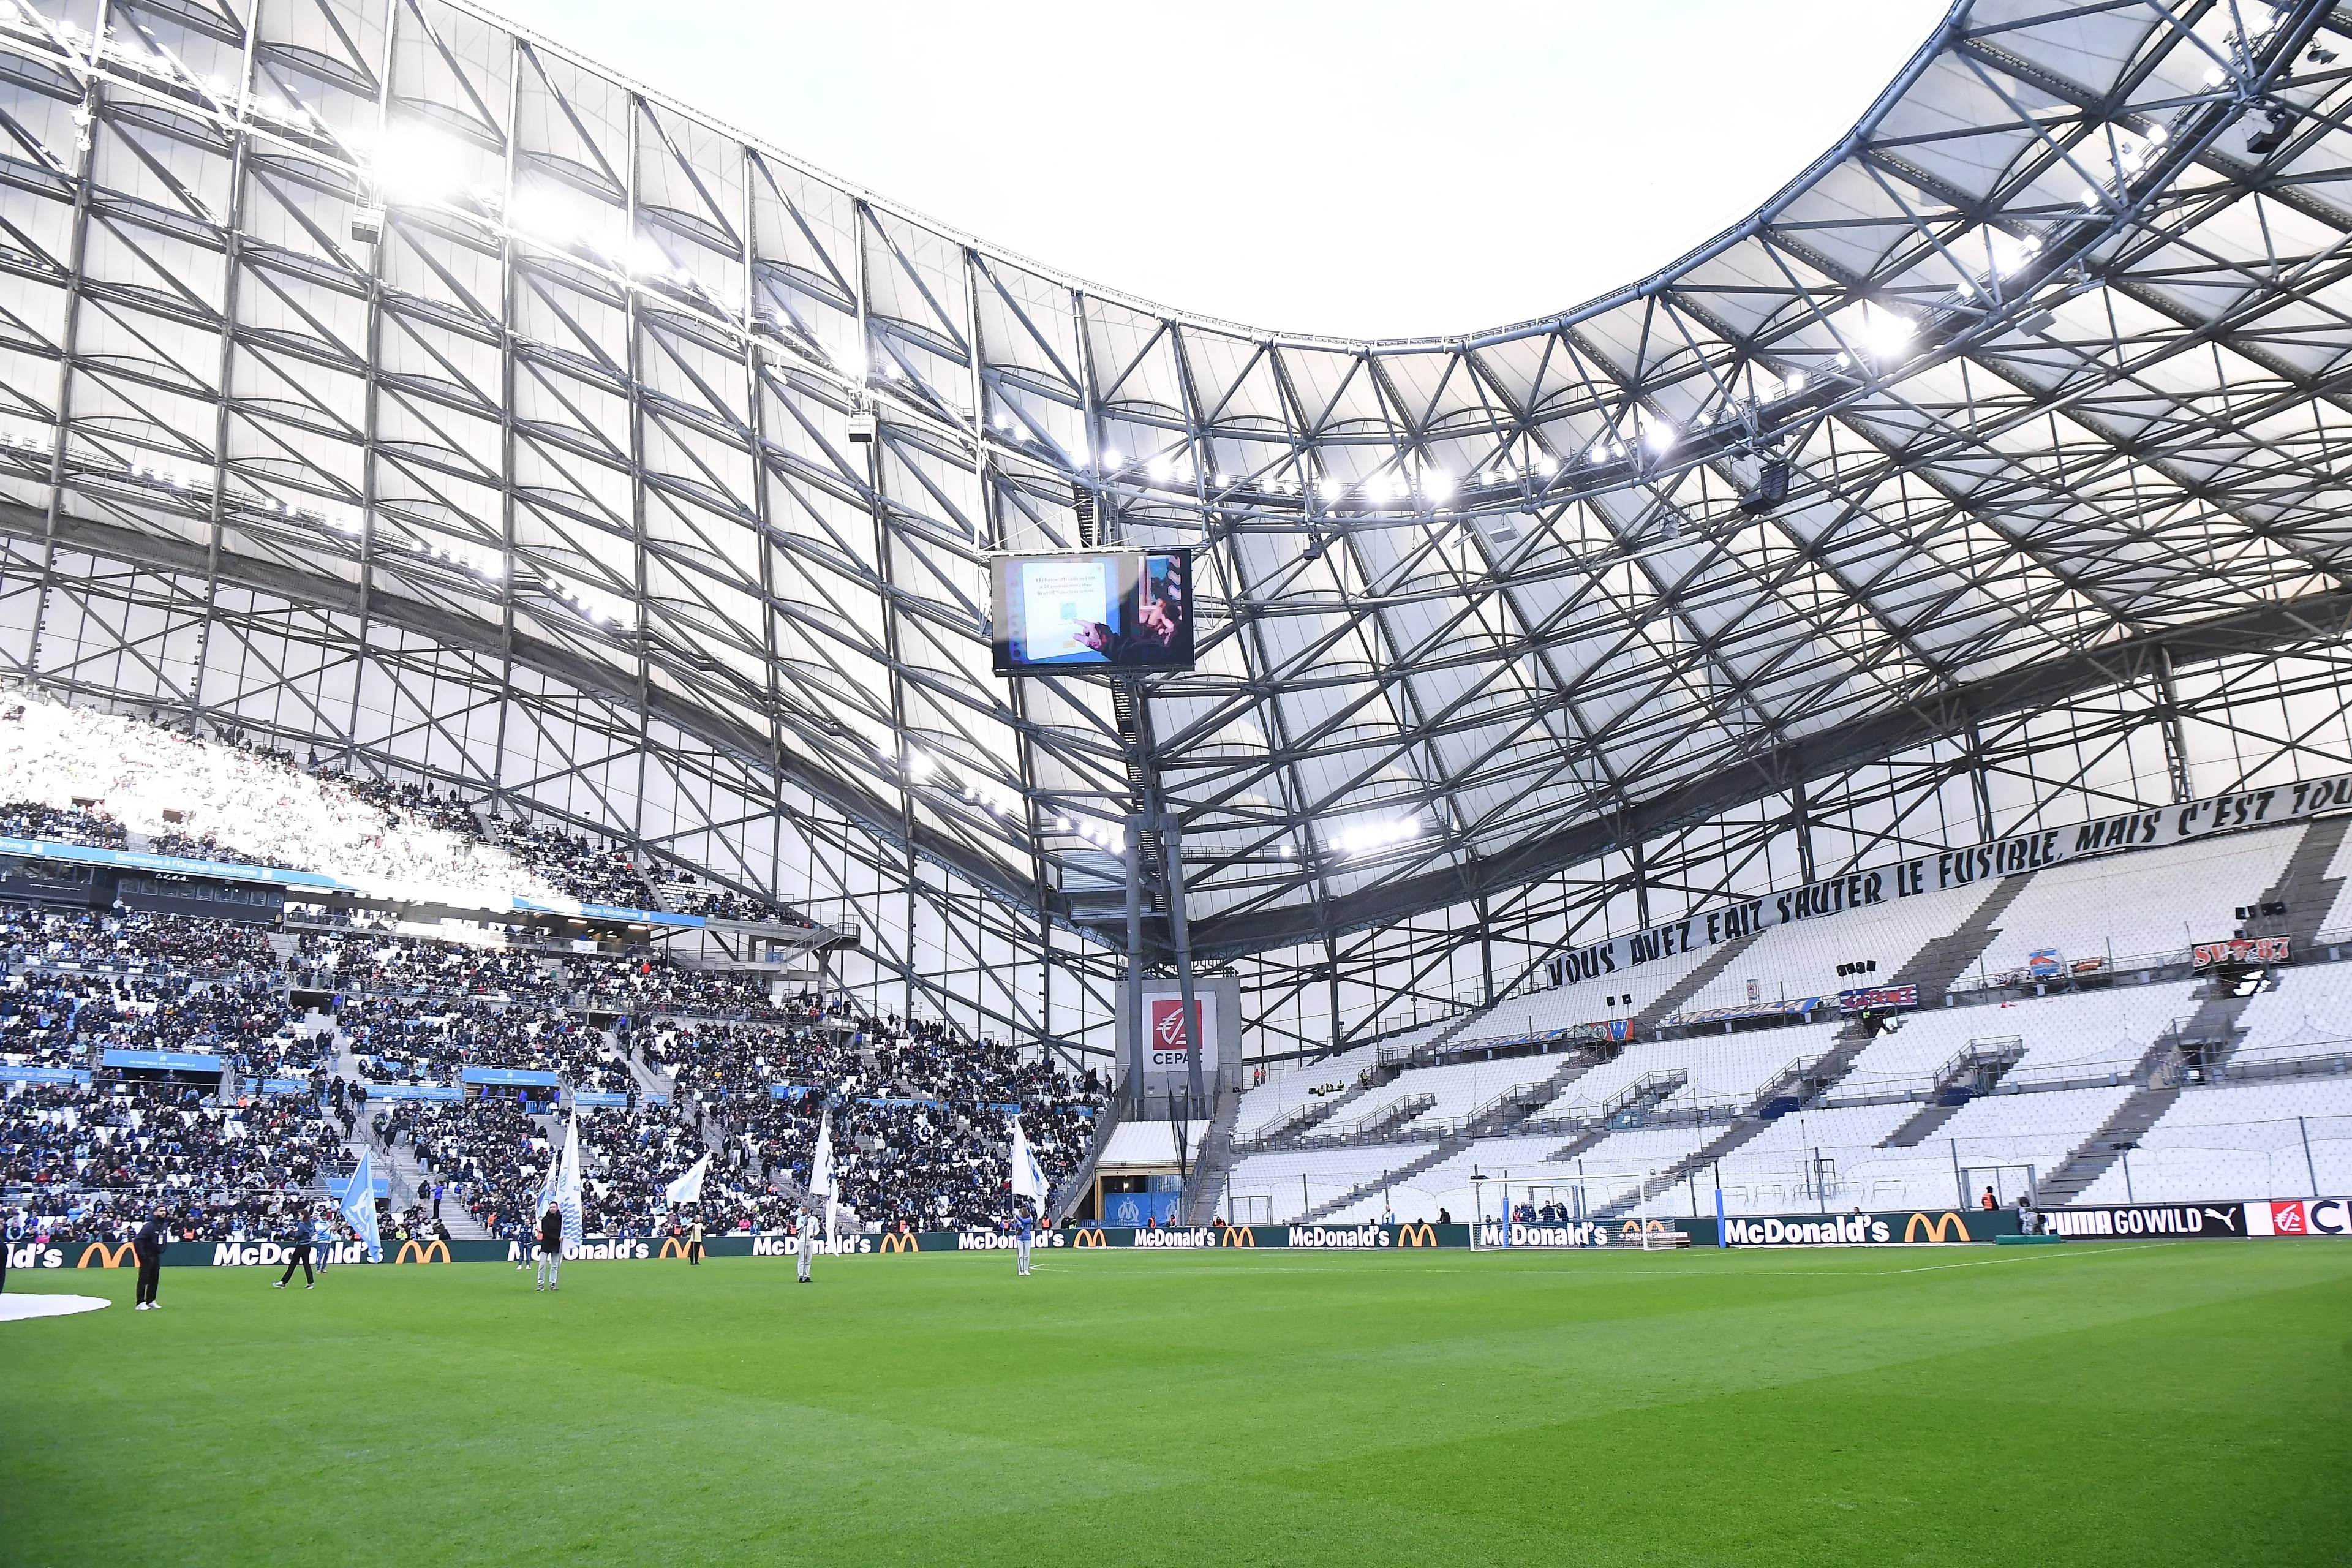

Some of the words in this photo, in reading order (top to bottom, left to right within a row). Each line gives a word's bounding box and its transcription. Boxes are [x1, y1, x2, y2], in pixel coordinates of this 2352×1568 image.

[115, 853, 162, 865] Bienvenue
[172, 861, 209, 871] l'Orange
[212, 864, 257, 876] Vélodrome
[1548, 943, 1615, 986] VOUS
[1630, 921, 1691, 965] AVEZ
[1707, 900, 1762, 944] FAIT
[1777, 872, 1882, 924] SAUTER
[1897, 861, 1923, 897] LE
[1939, 831, 2062, 888] FUSIBLE,
[2075, 811, 2160, 852] MAIS
[2178, 790, 2275, 836] C'EST
[603, 908, 639, 918] Vélodrome
[1725, 1215, 1890, 1245] McDonald's
[2041, 1210, 2113, 1235] PUMA
[1134, 1227, 1216, 1247] McDonald's
[1289, 1225, 1390, 1247] McDonald's
